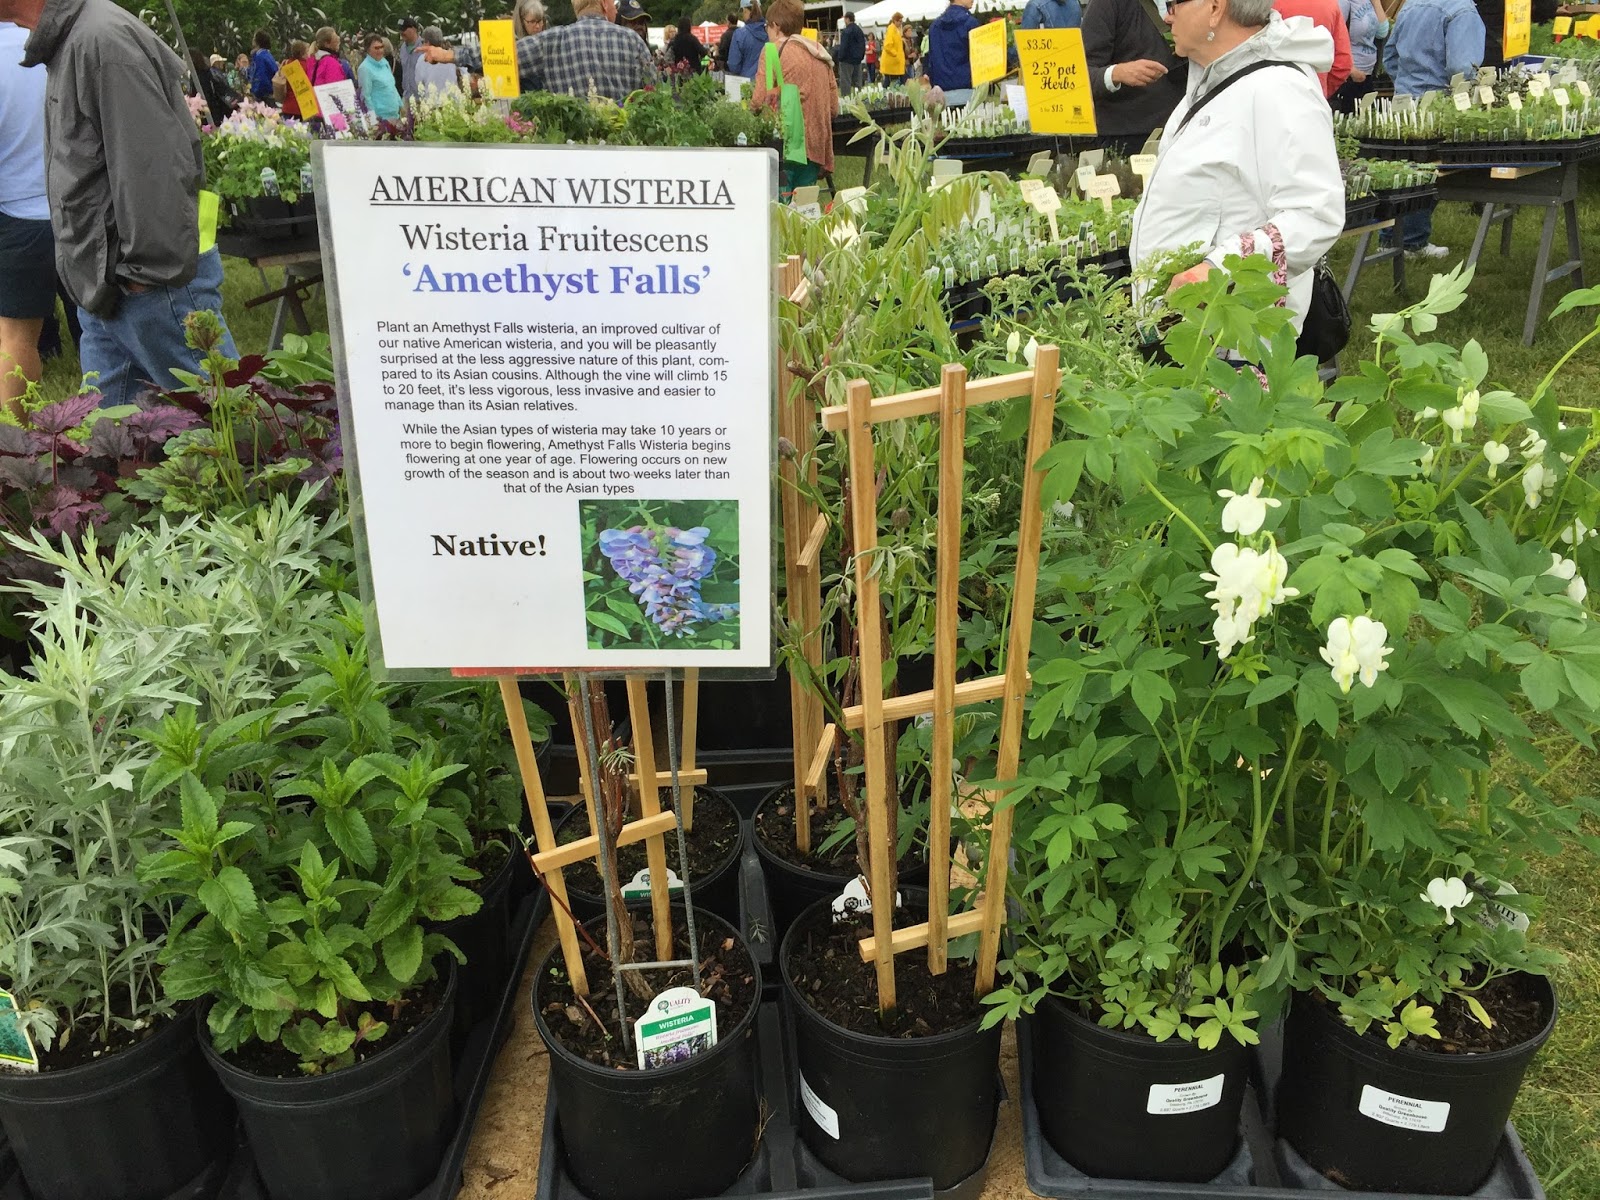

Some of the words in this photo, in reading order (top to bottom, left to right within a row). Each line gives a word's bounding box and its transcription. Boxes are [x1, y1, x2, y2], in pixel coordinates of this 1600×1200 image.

[1057, 63, 1077, 79] pot
[1040, 76, 1076, 90] Herbs
[369, 175, 557, 204] AMERICAN
[565, 178, 736, 205] WISTERIA
[399, 223, 529, 251] Wisteria
[537, 225, 708, 252] Fruitescens
[377, 321, 410, 332] Plant
[413, 324, 429, 332] an
[432, 322, 491, 336] Amethyst
[494, 322, 523, 333] Falls
[527, 322, 578, 335] wisteria,
[582, 325, 597, 334] an
[601, 323, 659, 336] improved
[661, 323, 705, 334] cultivar
[709, 323, 721, 334] of
[379, 340, 399, 348] our
[403, 337, 440, 348] native
[443, 337, 502, 349] American
[505, 338, 556, 351] wisteria,
[560, 339, 583, 349] and
[587, 341, 609, 352] you
[613, 339, 632, 350] will
[636, 339, 651, 350] be
[655, 339, 716, 353] pleasantly
[380, 353, 438, 367] surprised
[442, 354, 454, 364] at
[457, 353, 476, 364] the
[480, 354, 505, 364] less
[509, 354, 575, 367] aggressive
[579, 355, 618, 365] nature
[622, 354, 633, 365] of
[636, 354, 658, 365] this
[662, 355, 694, 368] plant,
[699, 357, 729, 366] com-
[382, 369, 417, 383] pared
[421, 369, 432, 379] to
[437, 369, 450, 379] its
[454, 369, 488, 380] Asian
[492, 369, 541, 380] cousins.
[545, 369, 599, 383] Although
[603, 370, 622, 381] the
[626, 370, 650, 381] vine
[654, 370, 673, 381] will
[677, 370, 709, 381] climb
[714, 370, 727, 381] 15
[383, 384, 395, 395] to
[398, 384, 414, 395] 20
[418, 384, 444, 396] feet,
[449, 384, 466, 395] it's
[469, 384, 493, 395] less
[497, 384, 552, 398] vigorous,
[557, 385, 581, 396] less
[585, 385, 634, 396] invasive
[638, 385, 660, 396] and
[664, 386, 701, 396] easier
[704, 386, 716, 396] to
[385, 402, 435, 413] manage
[438, 400, 465, 410] than
[469, 400, 482, 410] its
[486, 400, 519, 410] Asian
[524, 400, 577, 411] relatives.
[403, 424, 437, 434] While
[441, 424, 460, 434] the
[463, 424, 497, 434] Asian
[501, 425, 533, 437] types
[537, 424, 549, 435] of
[551, 424, 598, 435] wisteria
[602, 427, 627, 438] may
[630, 425, 656, 435] take
[661, 425, 675, 435] 10
[678, 427, 711, 438] years
[715, 427, 727, 435] or
[400, 441, 431, 449] more
[435, 439, 446, 449] to
[450, 439, 483, 452] begin
[486, 439, 545, 452] flowering,
[548, 439, 604, 452] Amethyst
[608, 439, 636, 450] Falls
[639, 439, 688, 450] Wisteria
[692, 440, 731, 453] begins
[406, 453, 460, 467] flowering
[464, 454, 476, 464] at
[479, 456, 502, 464] one
[505, 456, 532, 467] year
[535, 454, 547, 464] of
[550, 456, 575, 467] age.
[580, 454, 637, 467] Flowering
[703, 457, 727, 465] new
[404, 468, 445, 481] growth
[449, 468, 460, 478] of
[463, 468, 482, 478] the
[486, 470, 529, 479] season
[533, 468, 555, 479] and
[559, 468, 569, 479] is
[572, 469, 606, 479] about
[609, 469, 629, 479] two
[633, 469, 671, 479] weeks
[675, 469, 701, 479] later
[705, 469, 730, 479] than
[504, 483, 527, 493] that
[529, 483, 541, 493] of
[544, 483, 563, 493] the
[565, 483, 599, 493] Asian
[603, 483, 634, 496] types
[430, 533, 546, 556] Native!
[658, 1014, 695, 1030] WISTERIA
[1174, 1084, 1204, 1093] PERENNIAL
[1388, 1096, 1422, 1109] PERENNIAL
